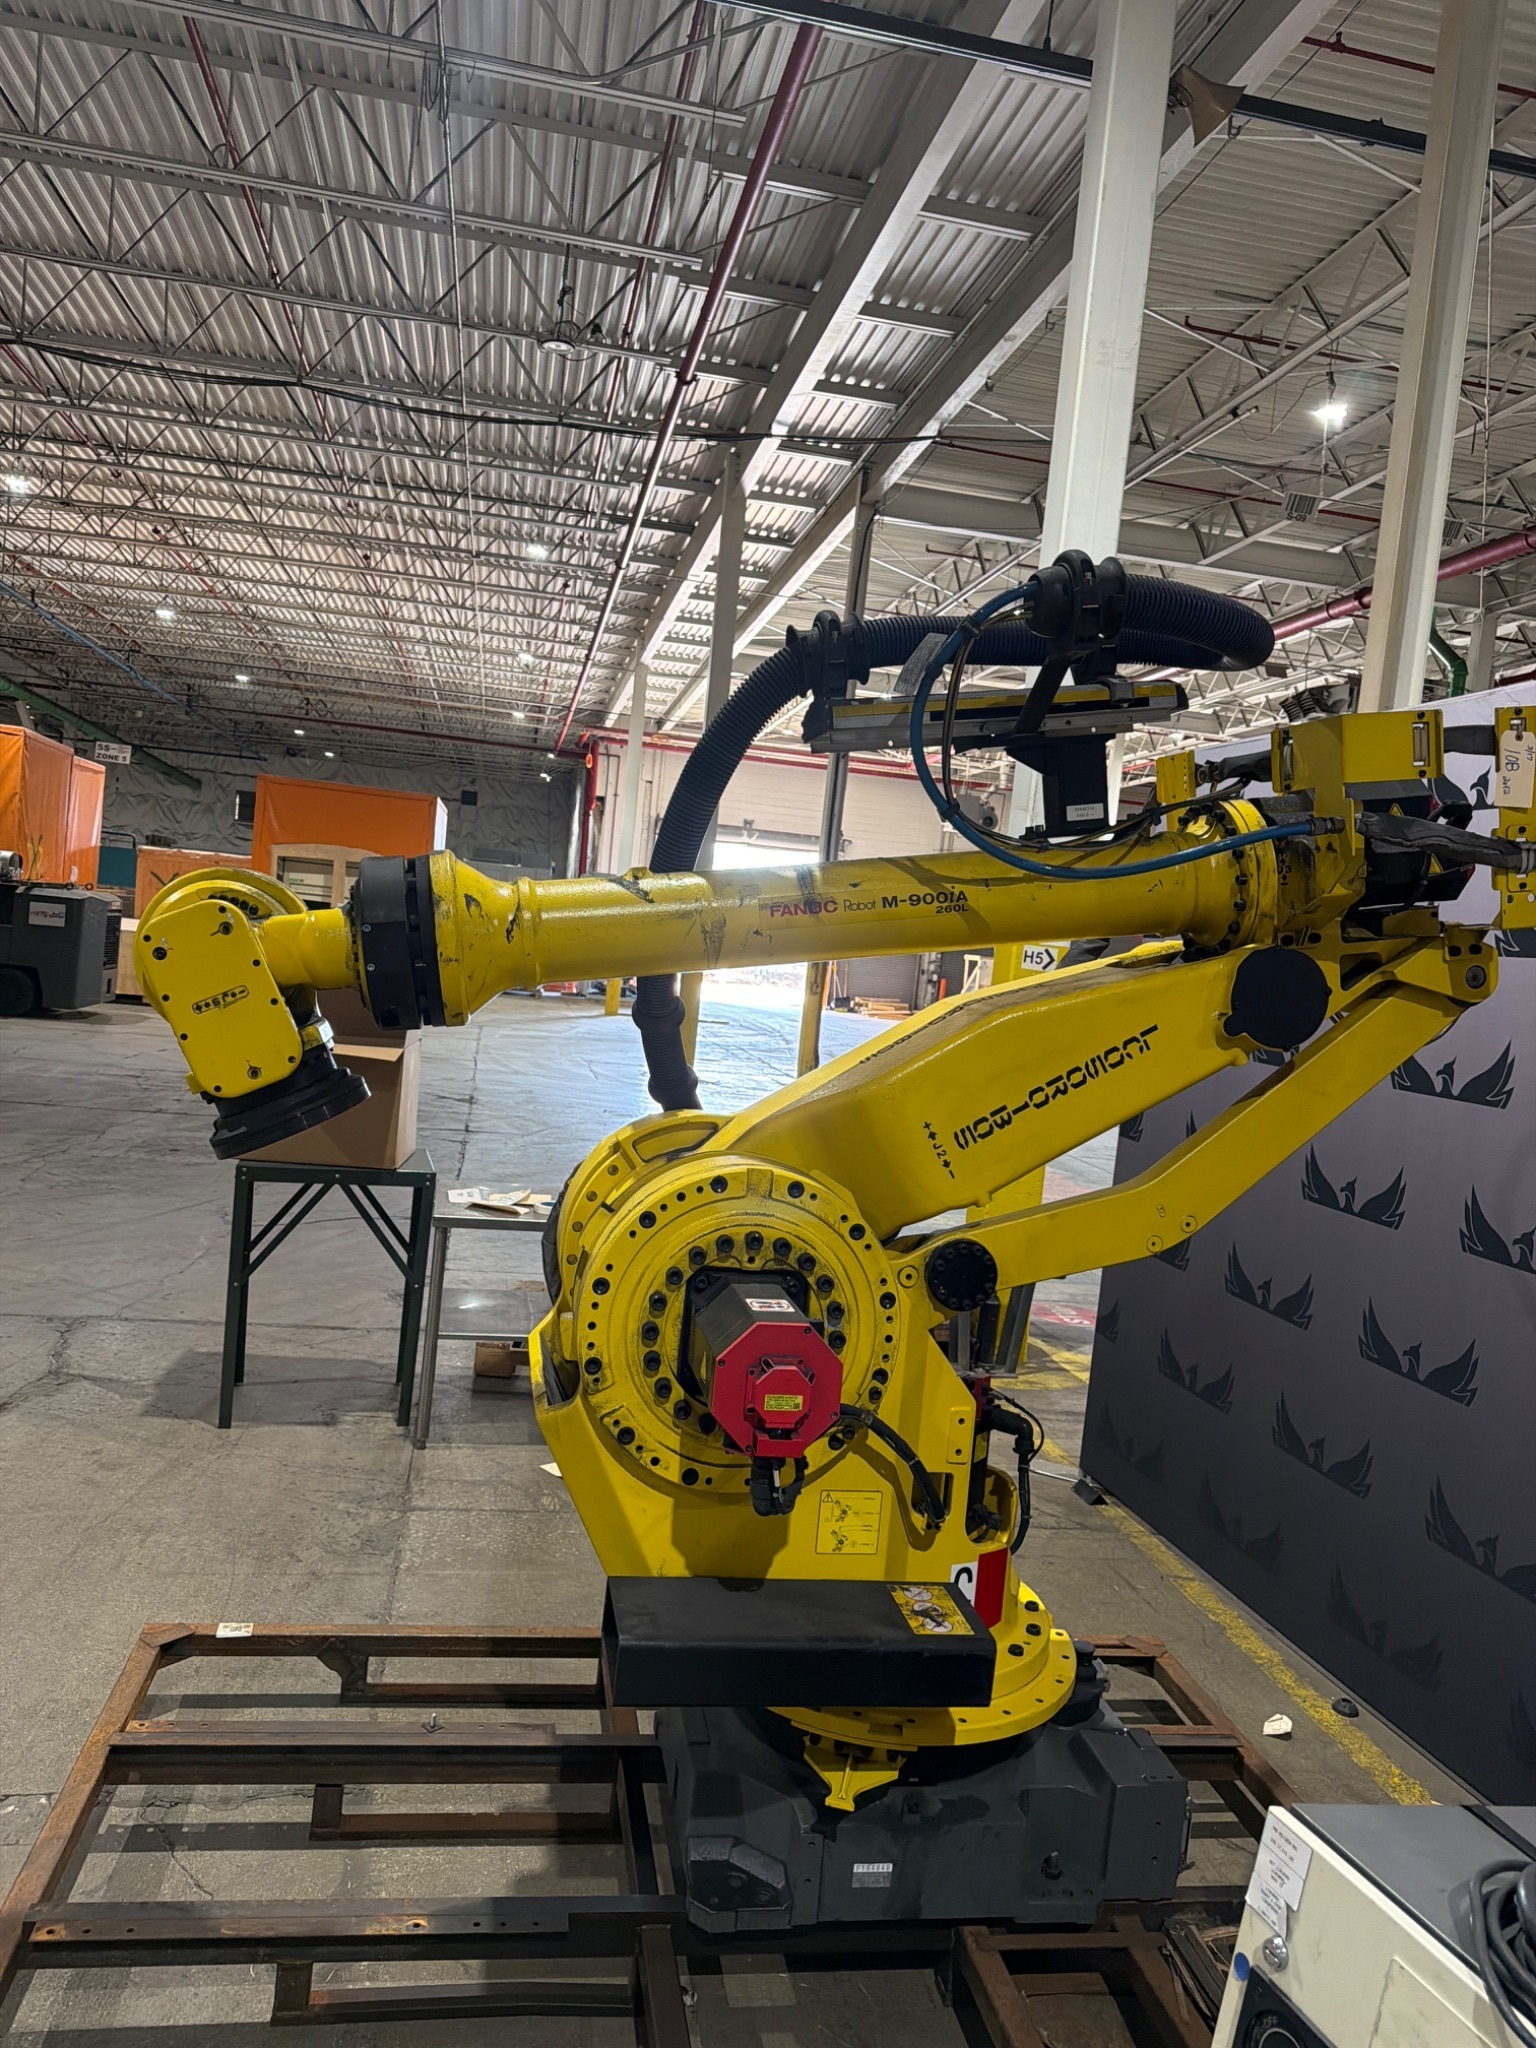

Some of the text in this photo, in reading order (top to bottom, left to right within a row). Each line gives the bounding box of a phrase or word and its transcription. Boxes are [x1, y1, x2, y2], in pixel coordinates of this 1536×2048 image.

[1286, 512, 1307, 522] S-09
[96, 752, 120, 761] ZONE
[769, 886, 968, 918] FANUC Robot M-900iA
[935, 904, 969, 914] 260L
[1023, 950, 1044, 965] H5
[933, 1143, 947, 1159] J2
